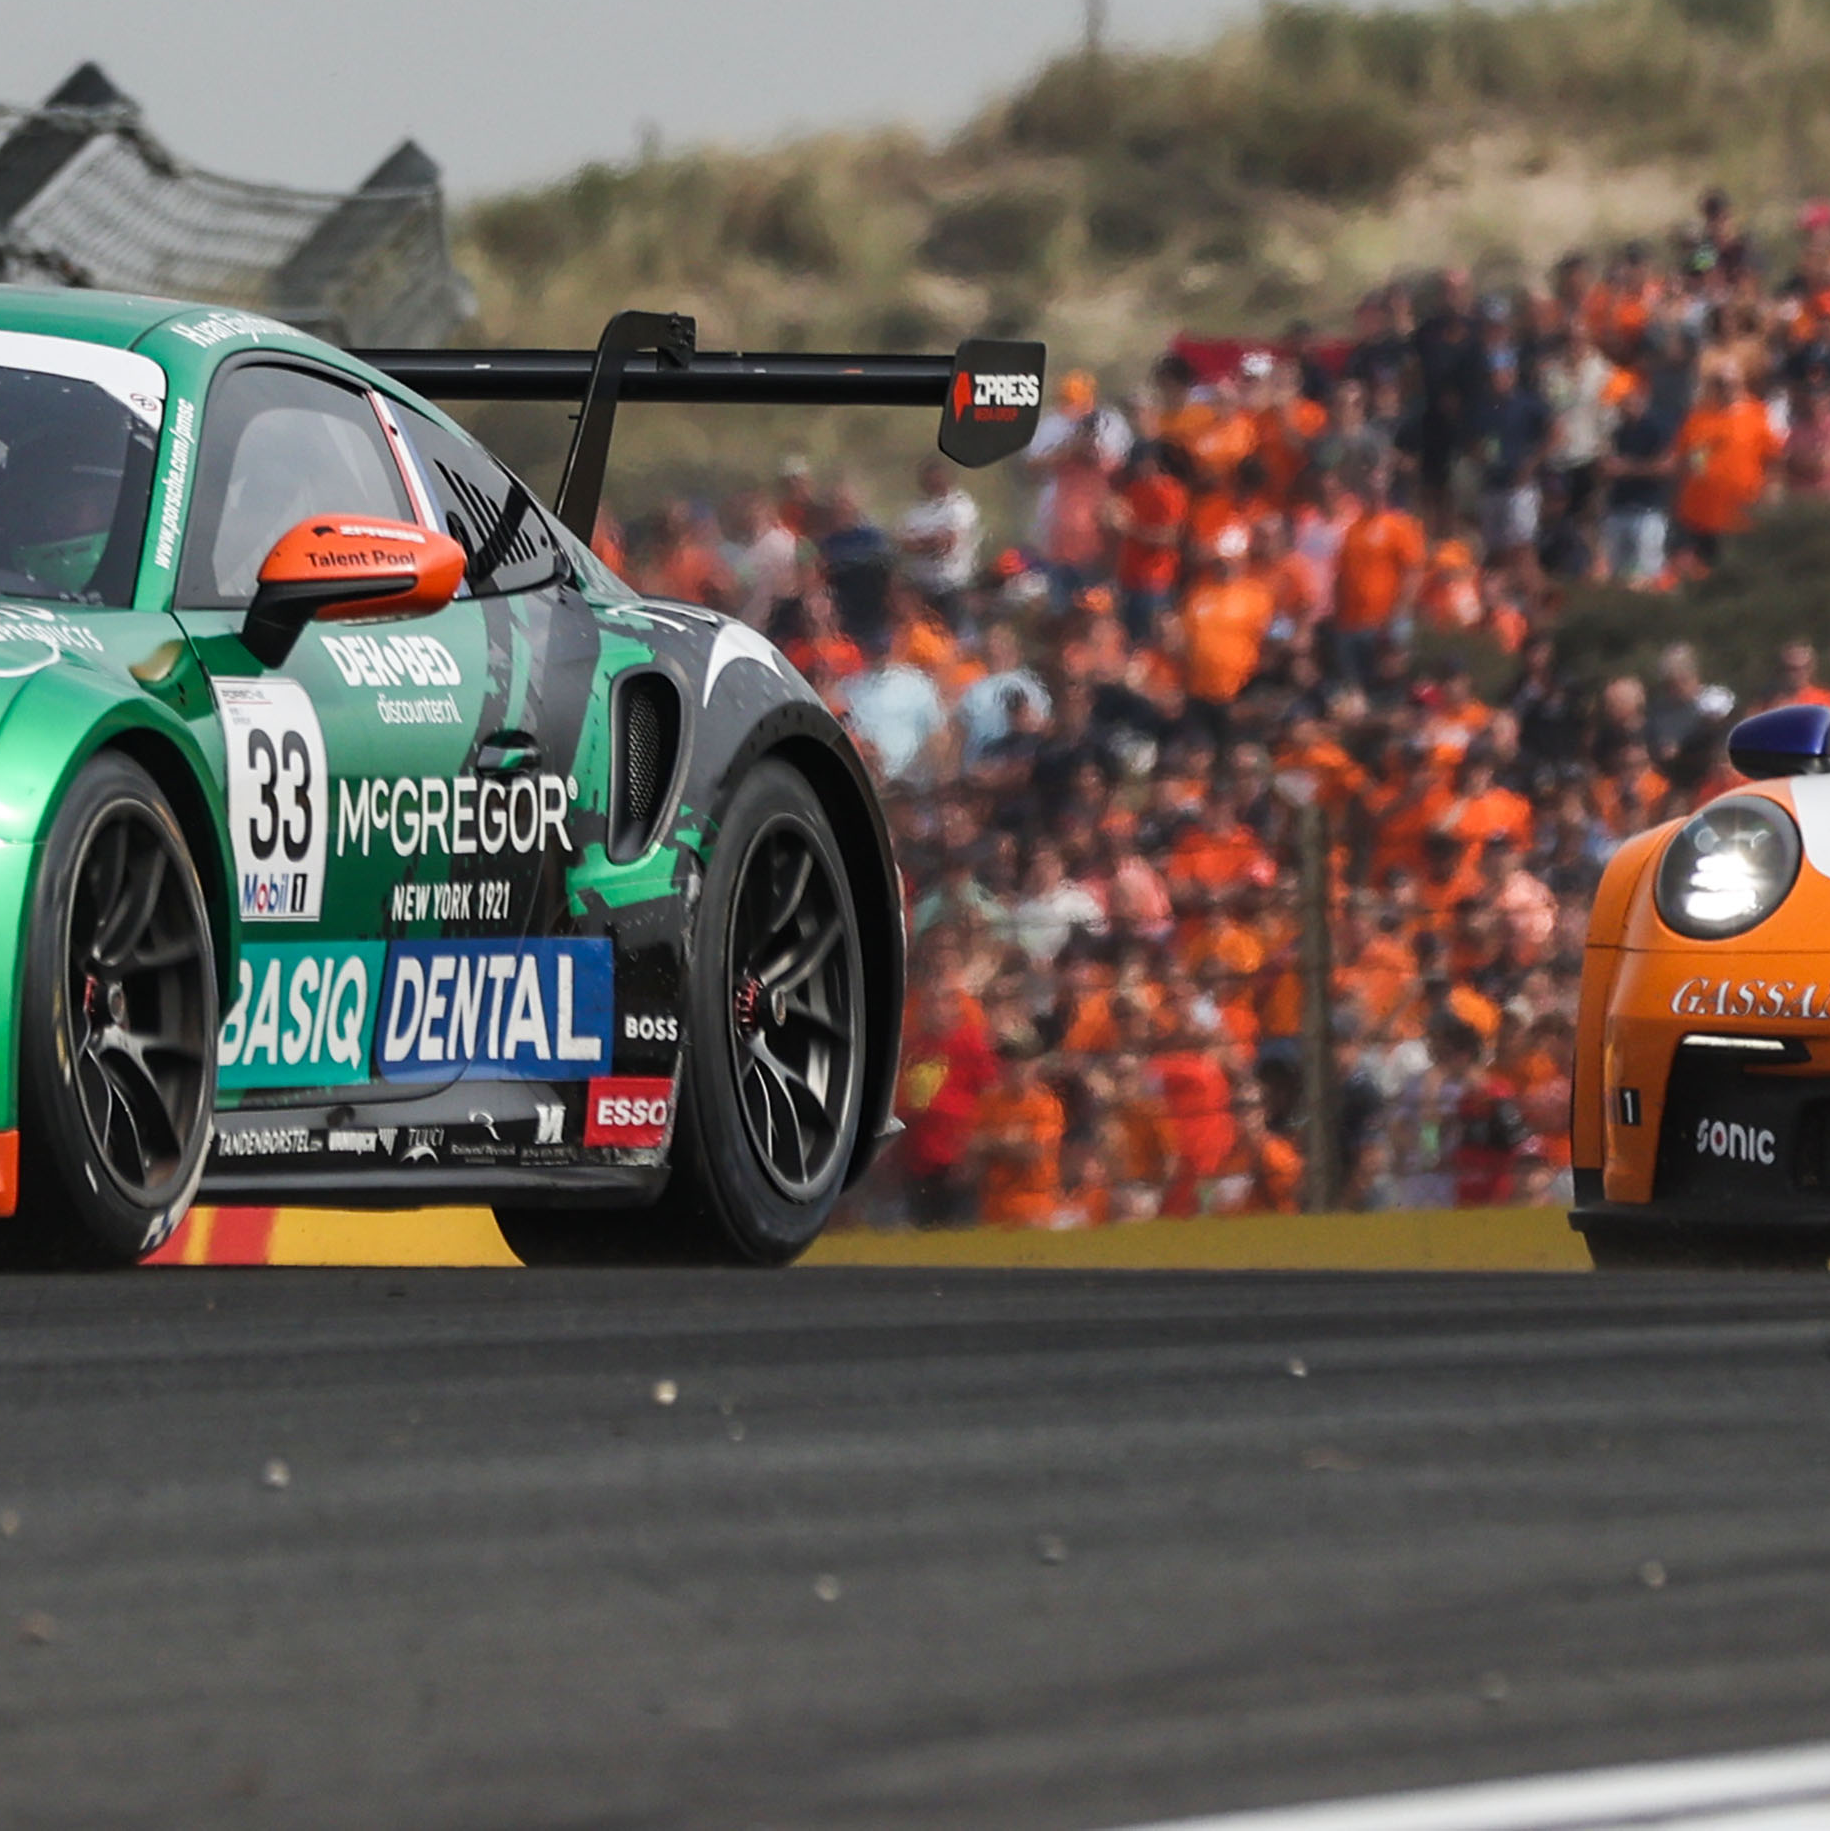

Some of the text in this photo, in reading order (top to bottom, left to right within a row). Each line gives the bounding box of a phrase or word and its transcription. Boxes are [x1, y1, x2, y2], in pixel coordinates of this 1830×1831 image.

[974, 373, 1040, 407] ZPRESS
[154, 397, 196, 571] www.porsche.com/pmsc
[306, 548, 417, 568] Talent Pool
[376, 692, 463, 724] discounter.nl
[247, 728, 313, 862] 33
[242, 873, 290, 914] Mobil
[391, 880, 510, 922] NEW YORK 1921
[217, 953, 603, 1070] BASIQ DENTAL
[624, 1016, 680, 1044] BOSS
[597, 1096, 668, 1128] ESSO
